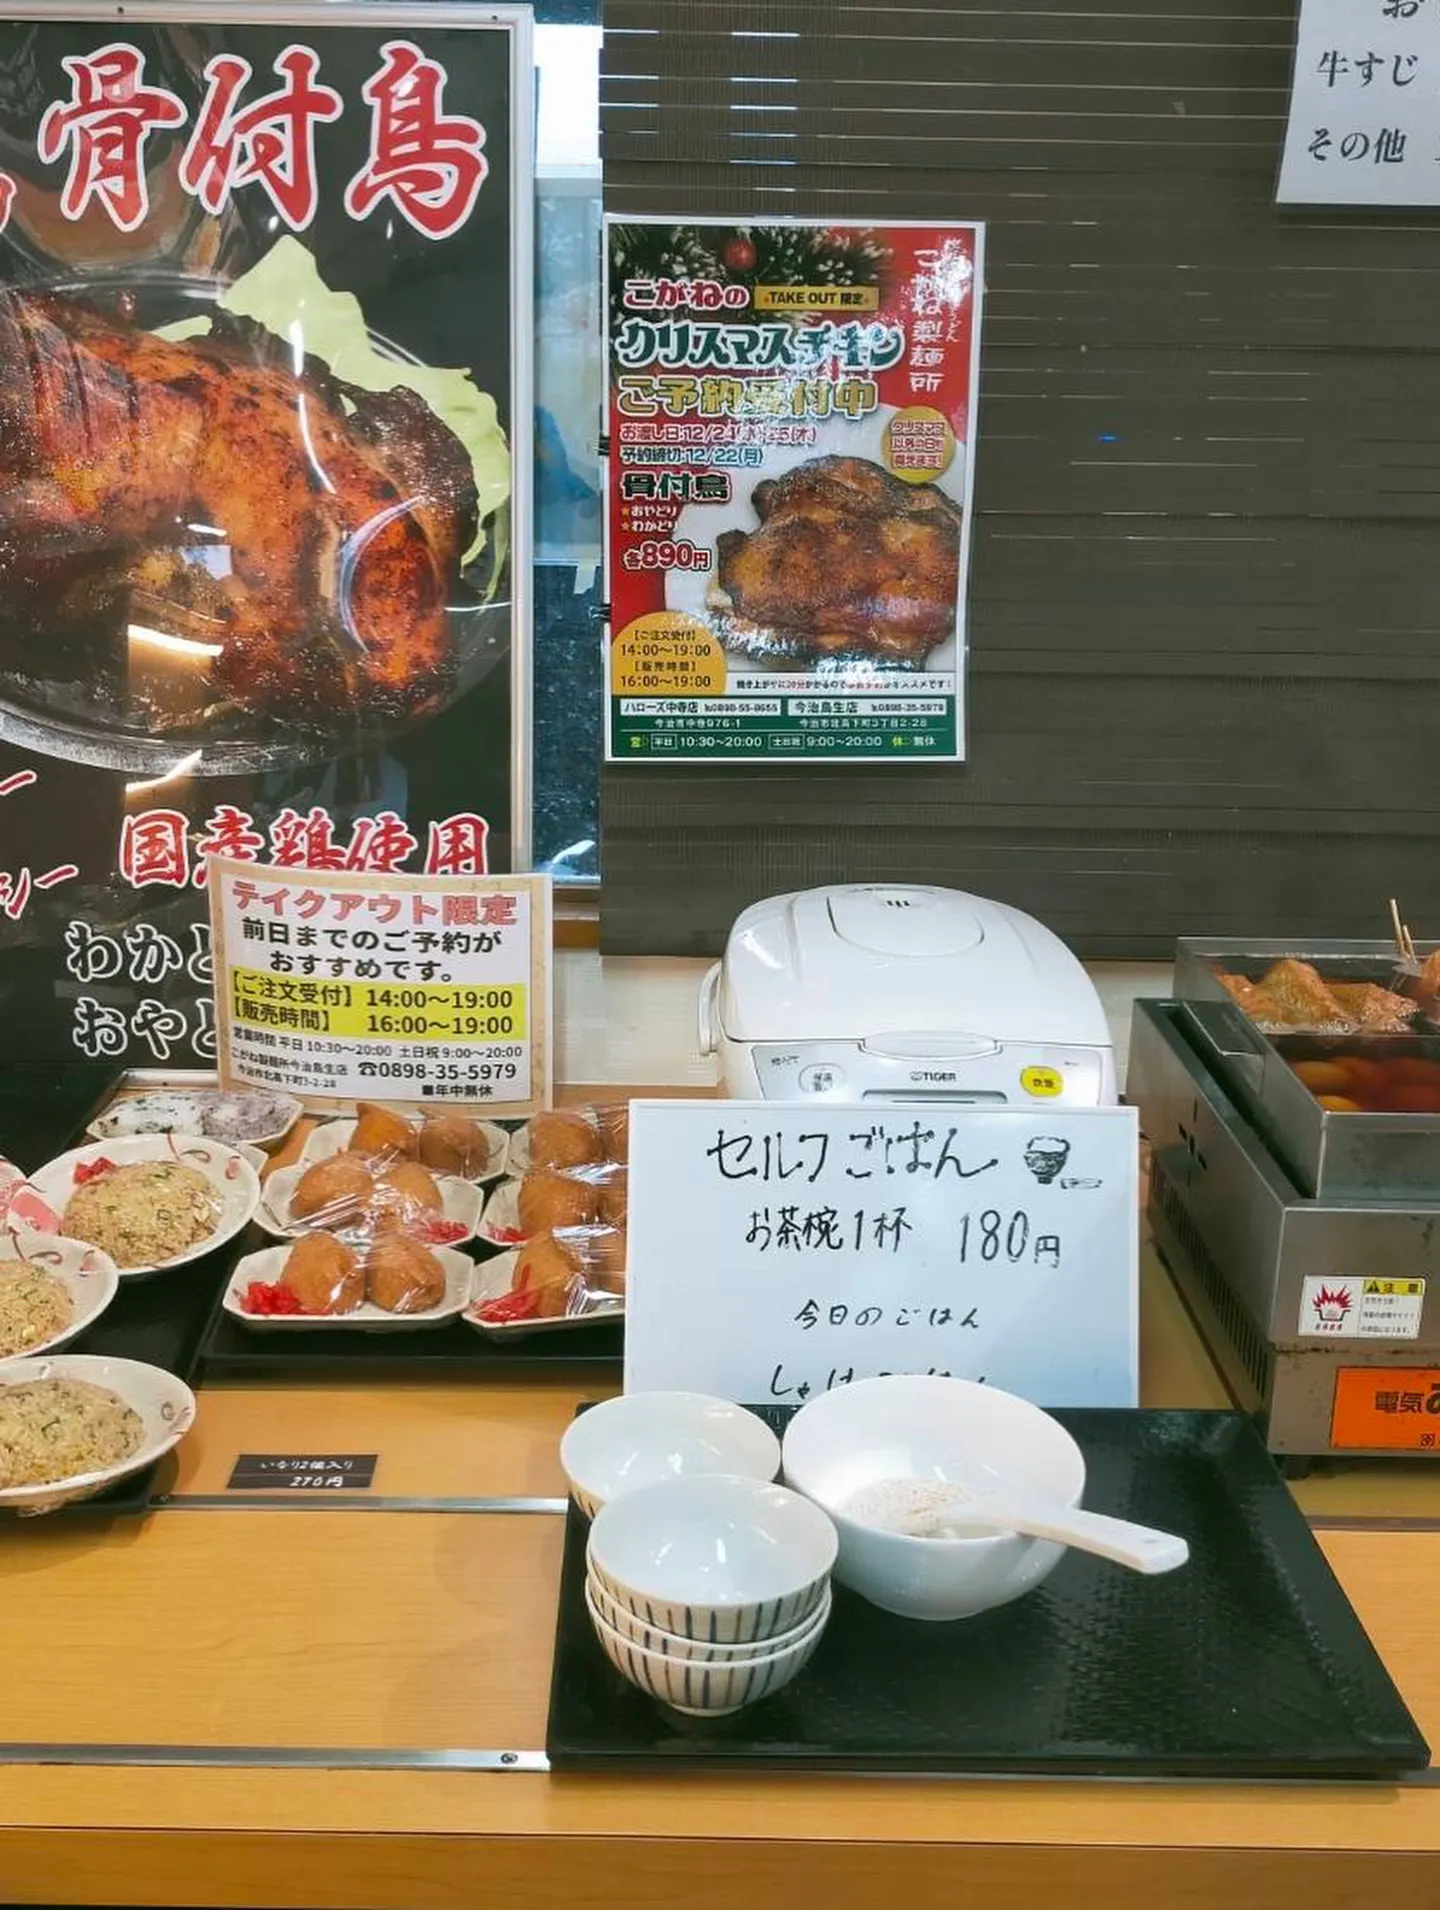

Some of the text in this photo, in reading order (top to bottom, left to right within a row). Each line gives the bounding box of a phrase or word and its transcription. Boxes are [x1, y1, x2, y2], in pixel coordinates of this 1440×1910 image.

[1316, 50, 1418, 87] 牛すじ
[37, 41, 487, 240] 骨付鳥
[1308, 128, 1407, 164] その他
[623, 279, 749, 308] こがねの
[769, 291, 805, 304] TAKE
[808, 292, 837, 304] OUT
[617, 321, 904, 369] クリスマスチキン
[618, 376, 877, 416] ご予約受付中
[622, 472, 730, 500] 骨付鳥
[631, 506, 677, 517] おやどり
[631, 520, 678, 532] わかどり
[624, 541, 712, 570] 各890円
[231, 880, 518, 927] テイクアウト限定
[242, 916, 502, 954] 前日までのご予約が
[270, 951, 454, 983] おすすめです。
[233, 970, 352, 1008] 【ご注文受付】
[233, 1000, 330, 1032] 【販売時間】
[923, 1072, 957, 1082] TIGER
[960, 1210, 1060, 1267] 180円
[794, 1299, 980, 1328] 今日のごはん
[290, 1476, 343, 1487] 270円
